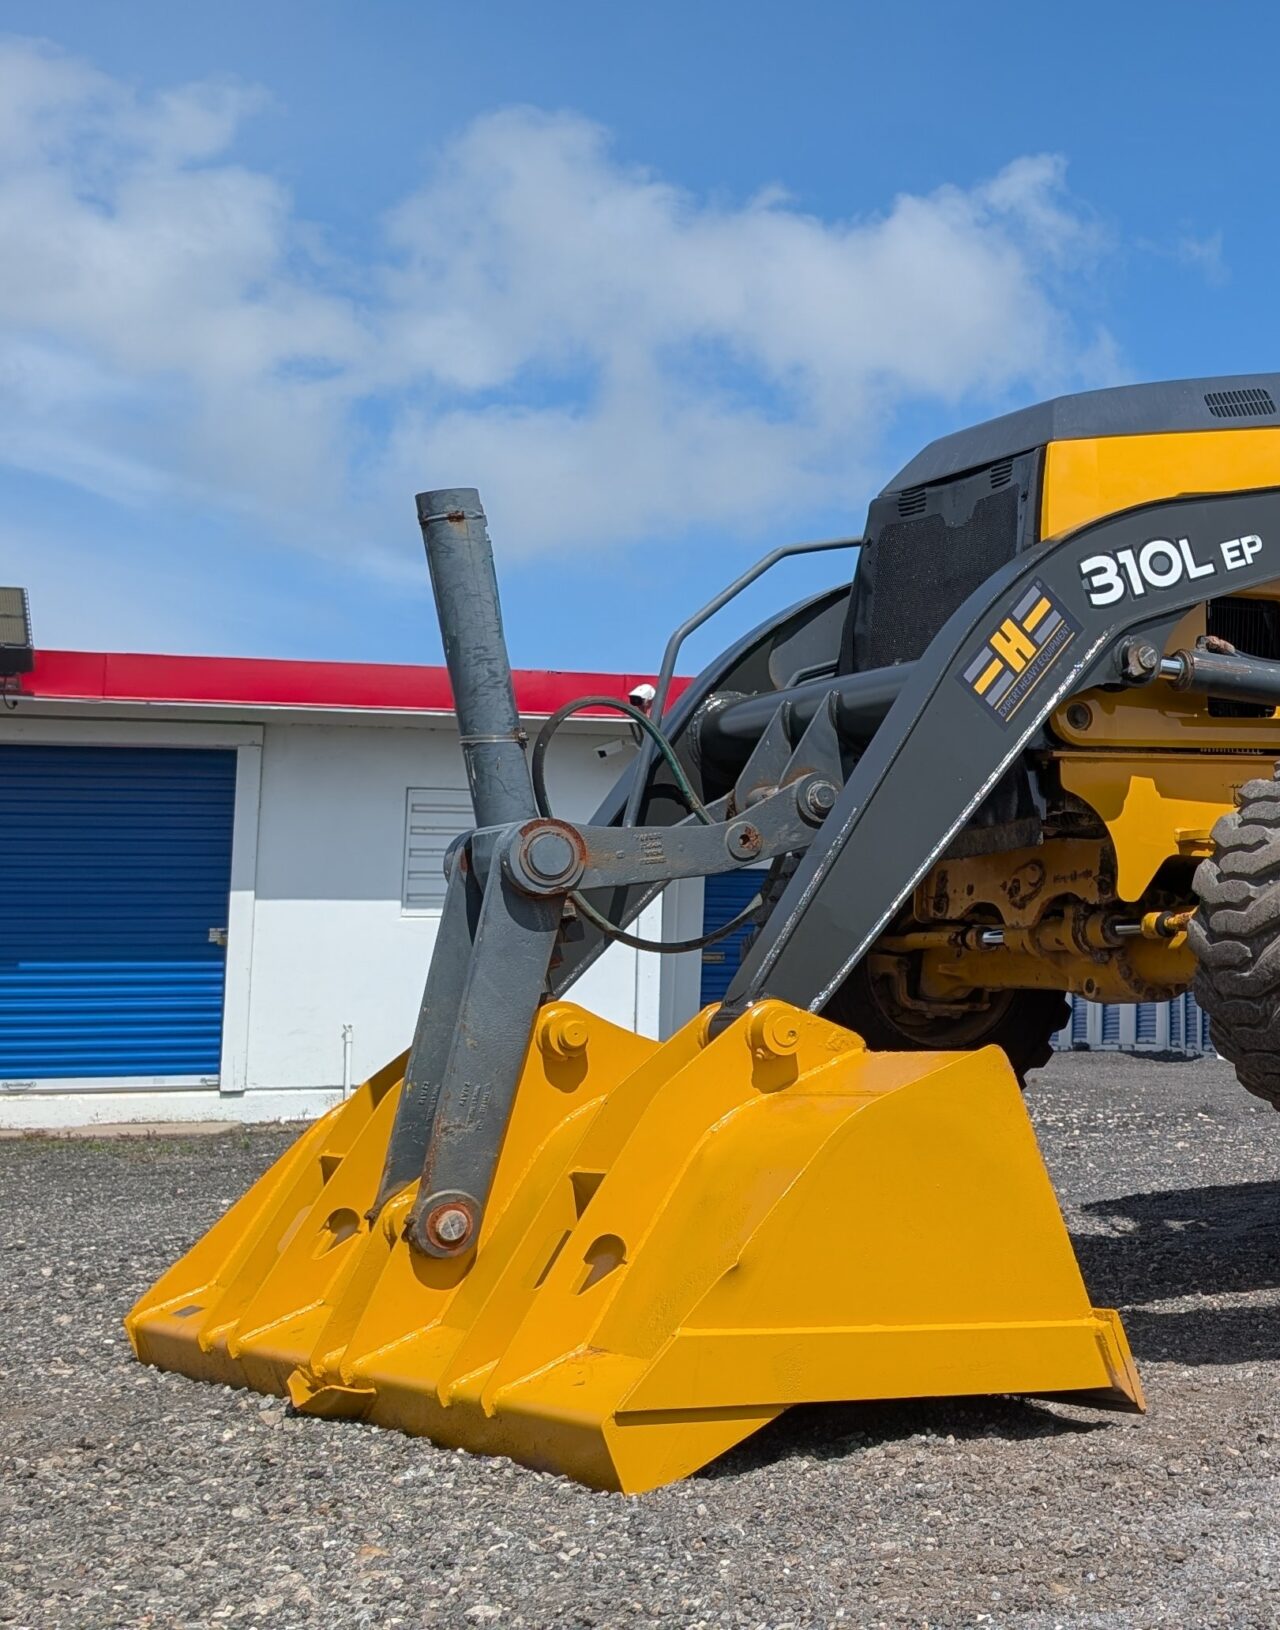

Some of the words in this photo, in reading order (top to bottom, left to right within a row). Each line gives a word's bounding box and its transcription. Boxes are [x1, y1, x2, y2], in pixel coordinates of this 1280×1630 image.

[1080, 538, 1215, 606] 310L
[1219, 534, 1263, 571] EP
[990, 618, 1037, 673] H
[998, 689, 1022, 718] EXPERT
[1020, 664, 1040, 691] HEAVY
[1038, 624, 1072, 667] EQUIPMENT
